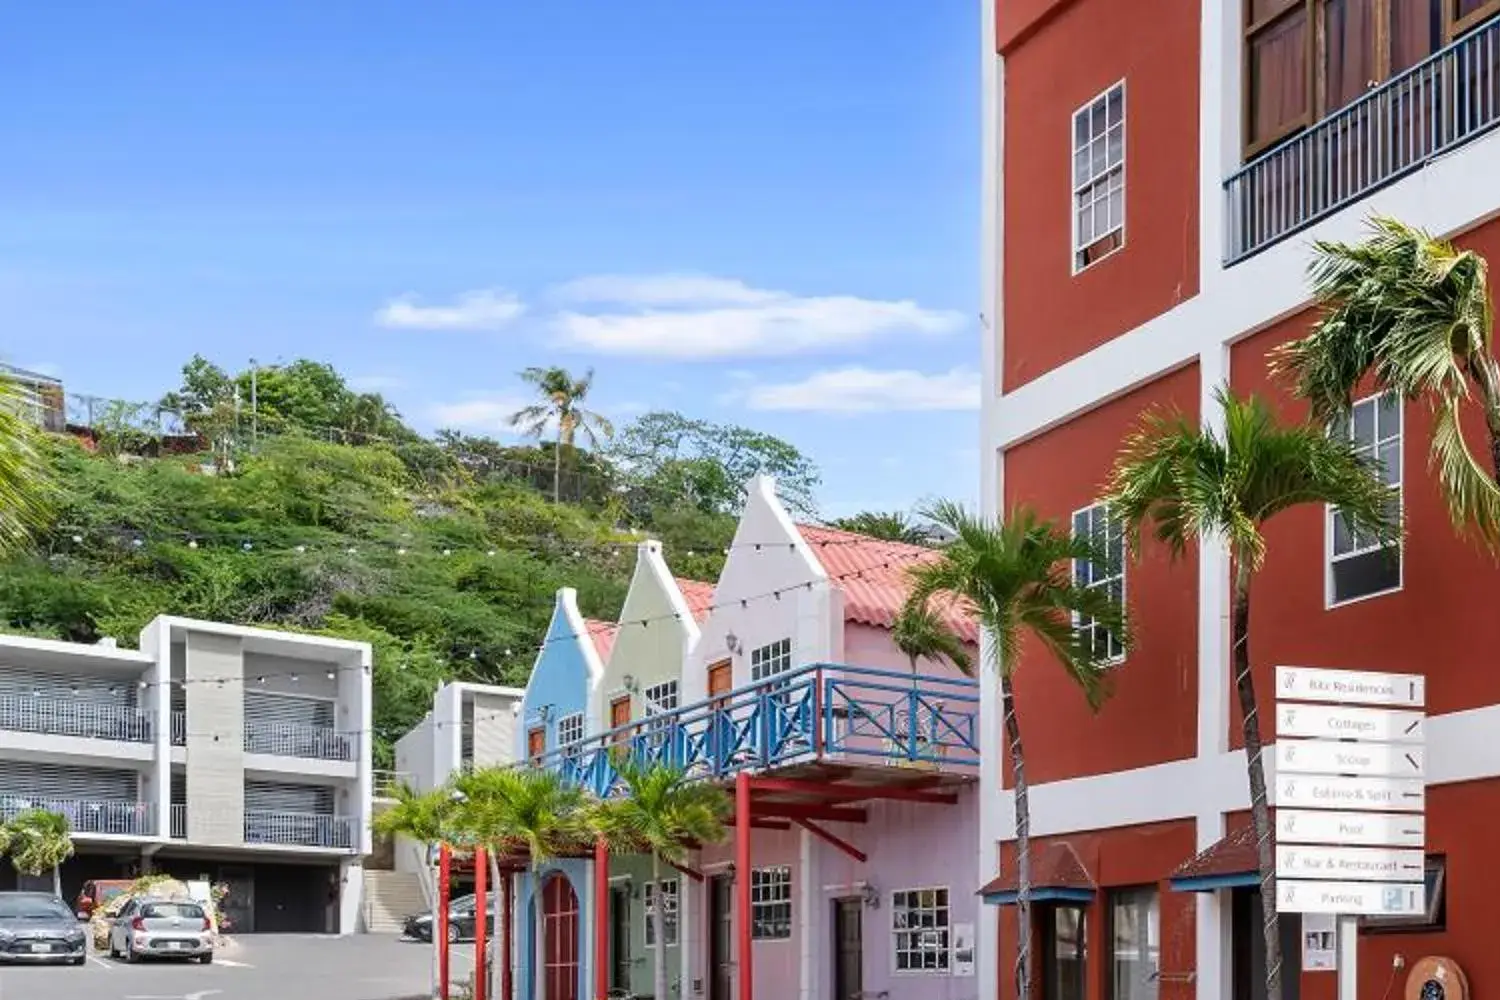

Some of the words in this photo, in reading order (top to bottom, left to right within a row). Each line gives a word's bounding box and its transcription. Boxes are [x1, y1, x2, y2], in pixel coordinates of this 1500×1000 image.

[1327, 716, 1377, 732] Cottages
[1338, 820, 1364, 835] Pool
[1303, 856, 1322, 869] Bar
[1325, 856, 1337, 869] &
[1338, 858, 1398, 872] Restaurant
[1320, 892, 1364, 907] Parking
